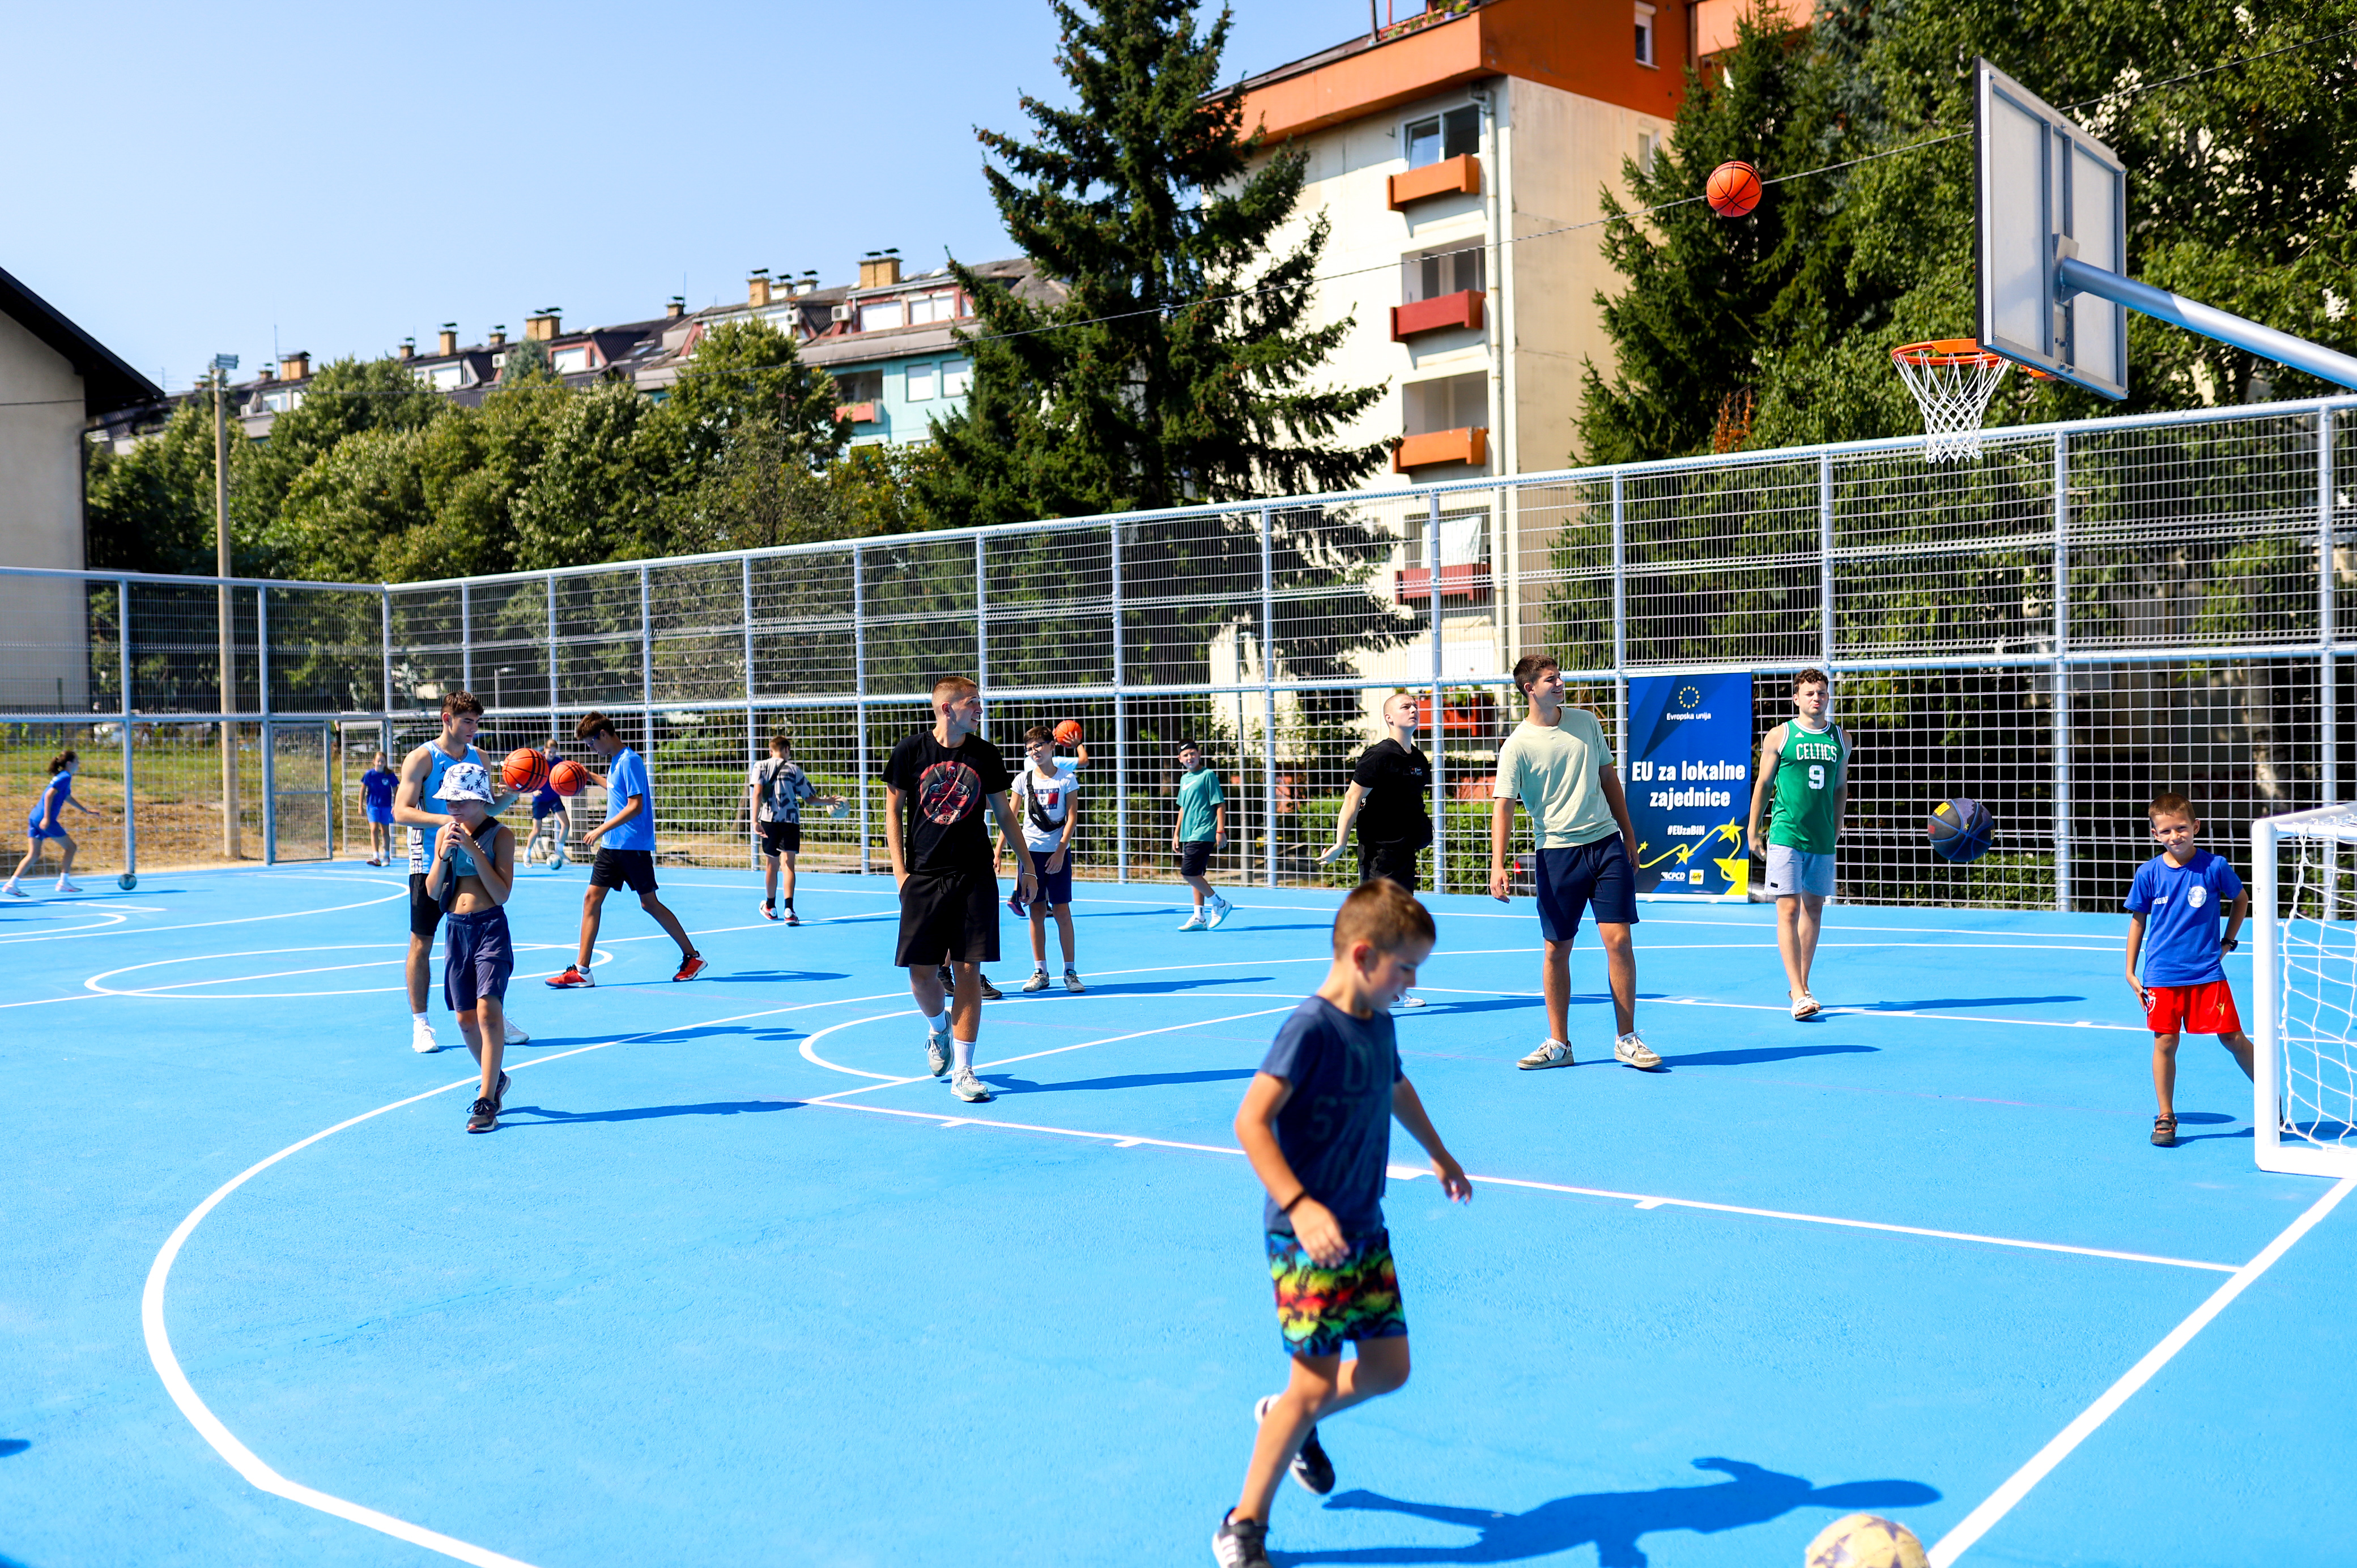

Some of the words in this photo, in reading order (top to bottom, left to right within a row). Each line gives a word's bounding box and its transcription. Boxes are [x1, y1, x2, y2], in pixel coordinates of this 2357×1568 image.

[1666, 712, 1694, 721] Evropska
[1696, 711, 1711, 721] unija
[1796, 743, 1837, 763] CELTICS
[1631, 761, 1653, 782] EU
[1658, 765, 1677, 781] za
[1681, 760, 1746, 781] lokalne
[1808, 764, 1825, 790] 9
[1649, 786, 1731, 811] zajednice
[1667, 825, 1705, 836] #EUzaBiH
